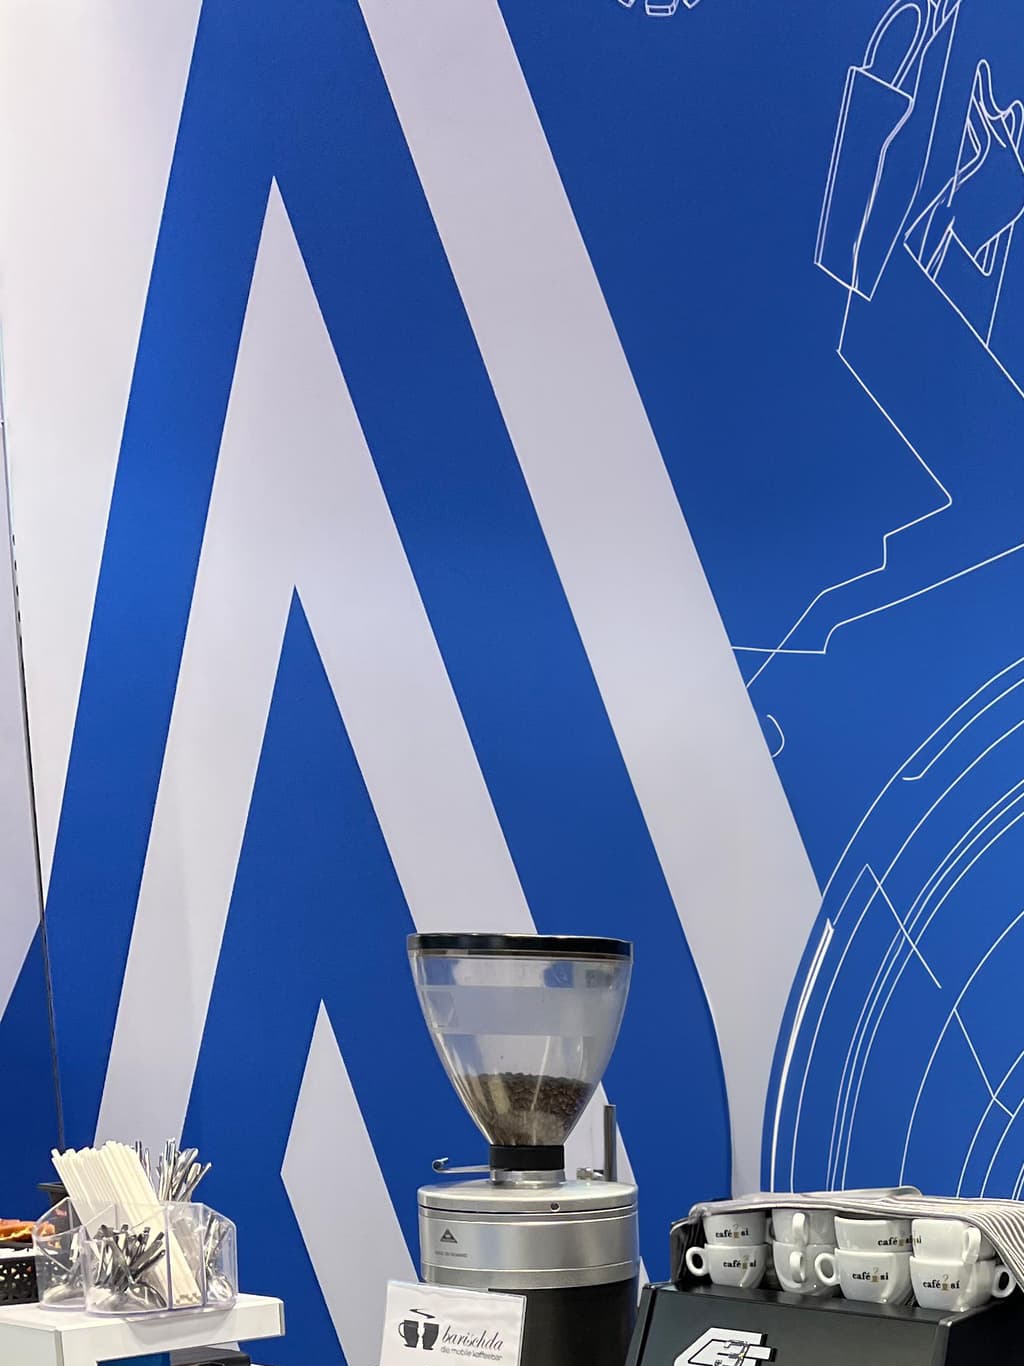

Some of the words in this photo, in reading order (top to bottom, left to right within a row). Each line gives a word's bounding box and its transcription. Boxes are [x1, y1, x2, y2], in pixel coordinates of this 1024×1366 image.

[715, 1228, 732, 1238] café
[878, 1237, 898, 1247] café
[723, 1259, 741, 1268] café
[852, 1271, 871, 1281] café
[922, 1279, 941, 1289] café
[441, 1325, 504, 1351] barischda
